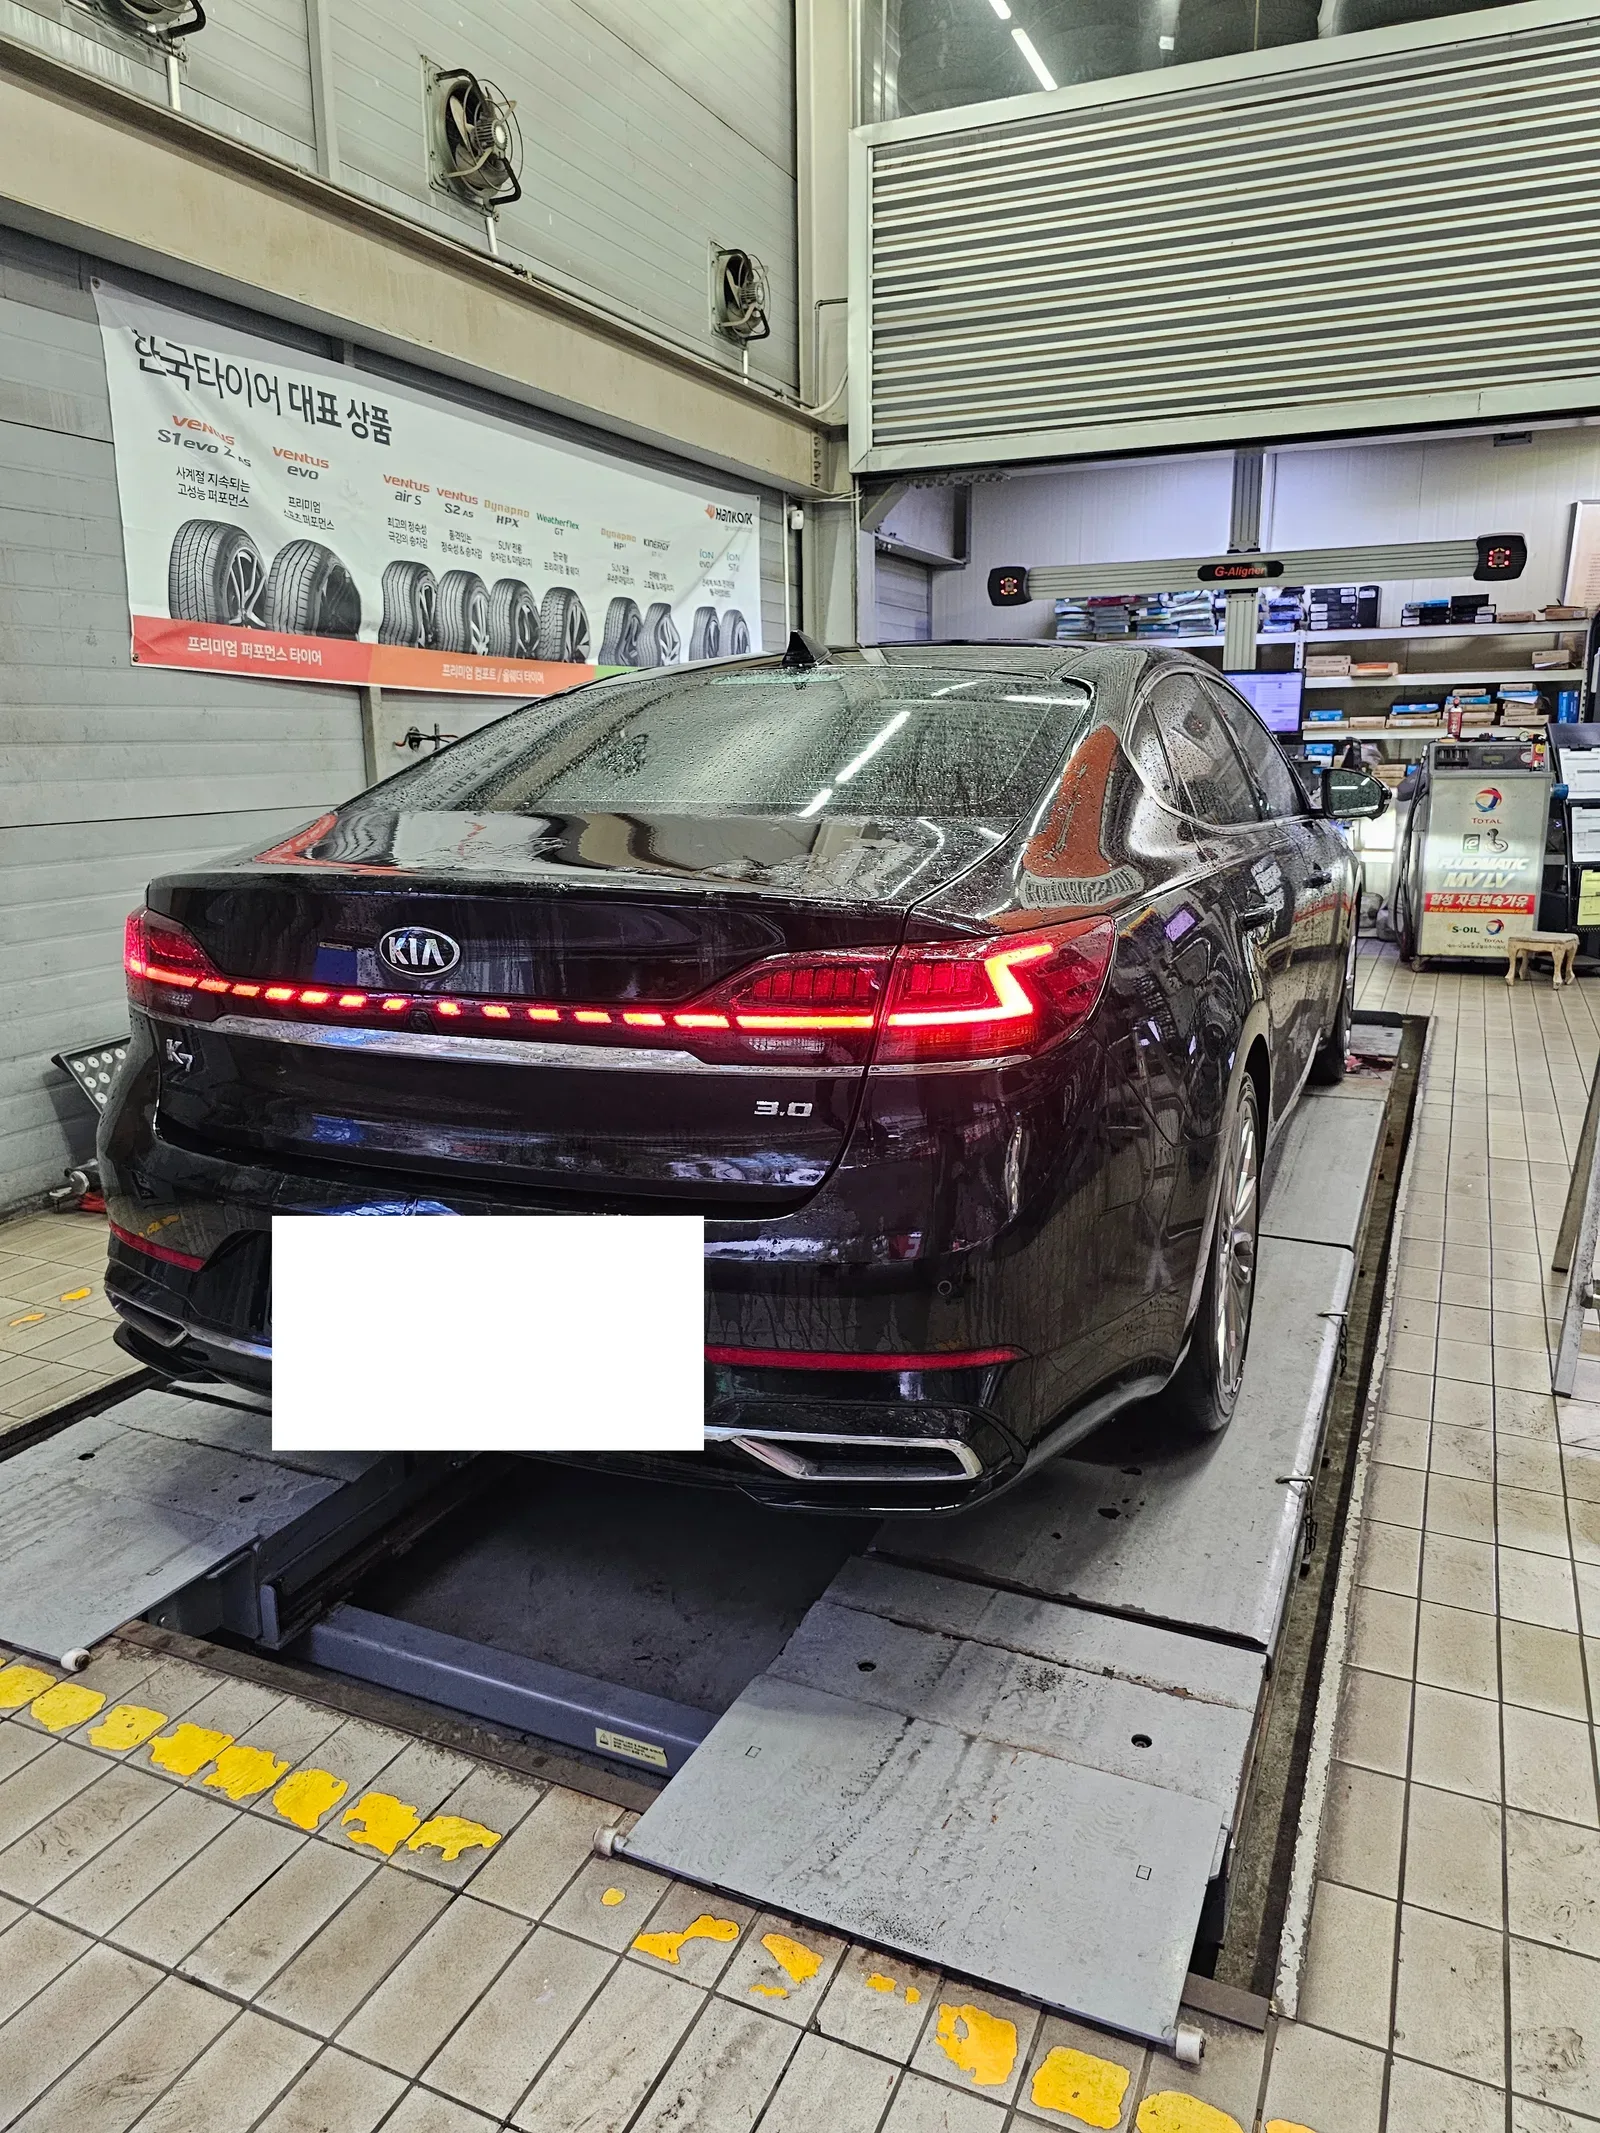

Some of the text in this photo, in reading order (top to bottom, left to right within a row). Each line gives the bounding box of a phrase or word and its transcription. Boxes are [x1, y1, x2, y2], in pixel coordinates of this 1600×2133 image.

[131, 328, 392, 446] 한국타이어 대표 상품
[157, 428, 181, 447] S1
[183, 439, 219, 454] evo
[175, 465, 251, 493] 사계절 지속되는
[287, 464, 319, 481] evo
[177, 483, 250, 508] 고성능 퍼포먼스
[394, 489, 422, 506] air S
[288, 496, 322, 514] 프리미엄
[444, 502, 474, 518] S2 AS
[302, 514, 336, 531] 퍼포먼스
[387, 517, 427, 535] 최고의 정숙성
[496, 515, 520, 528] HPX
[536, 512, 580, 530] Weatherflex
[388, 530, 428, 549] 극강의 승차감
[554, 527, 564, 536] GT
[498, 540, 512, 551] SUV
[643, 537, 671, 551] KINERGY
[1214, 566, 1266, 578] G-Aligner
[187, 635, 323, 667] 프리미엄 퍼포먼스 타이어
[441, 663, 473, 680] 프리미엄
[524, 670, 545, 684] 타이어
[1430, 893, 1530, 907] 합성 자동변속기유
[1452, 926, 1480, 934] S-OIL
[388, 936, 445, 967] KIA
[165, 1038, 194, 1072] K7
[753, 1100, 814, 1117] 3.0
